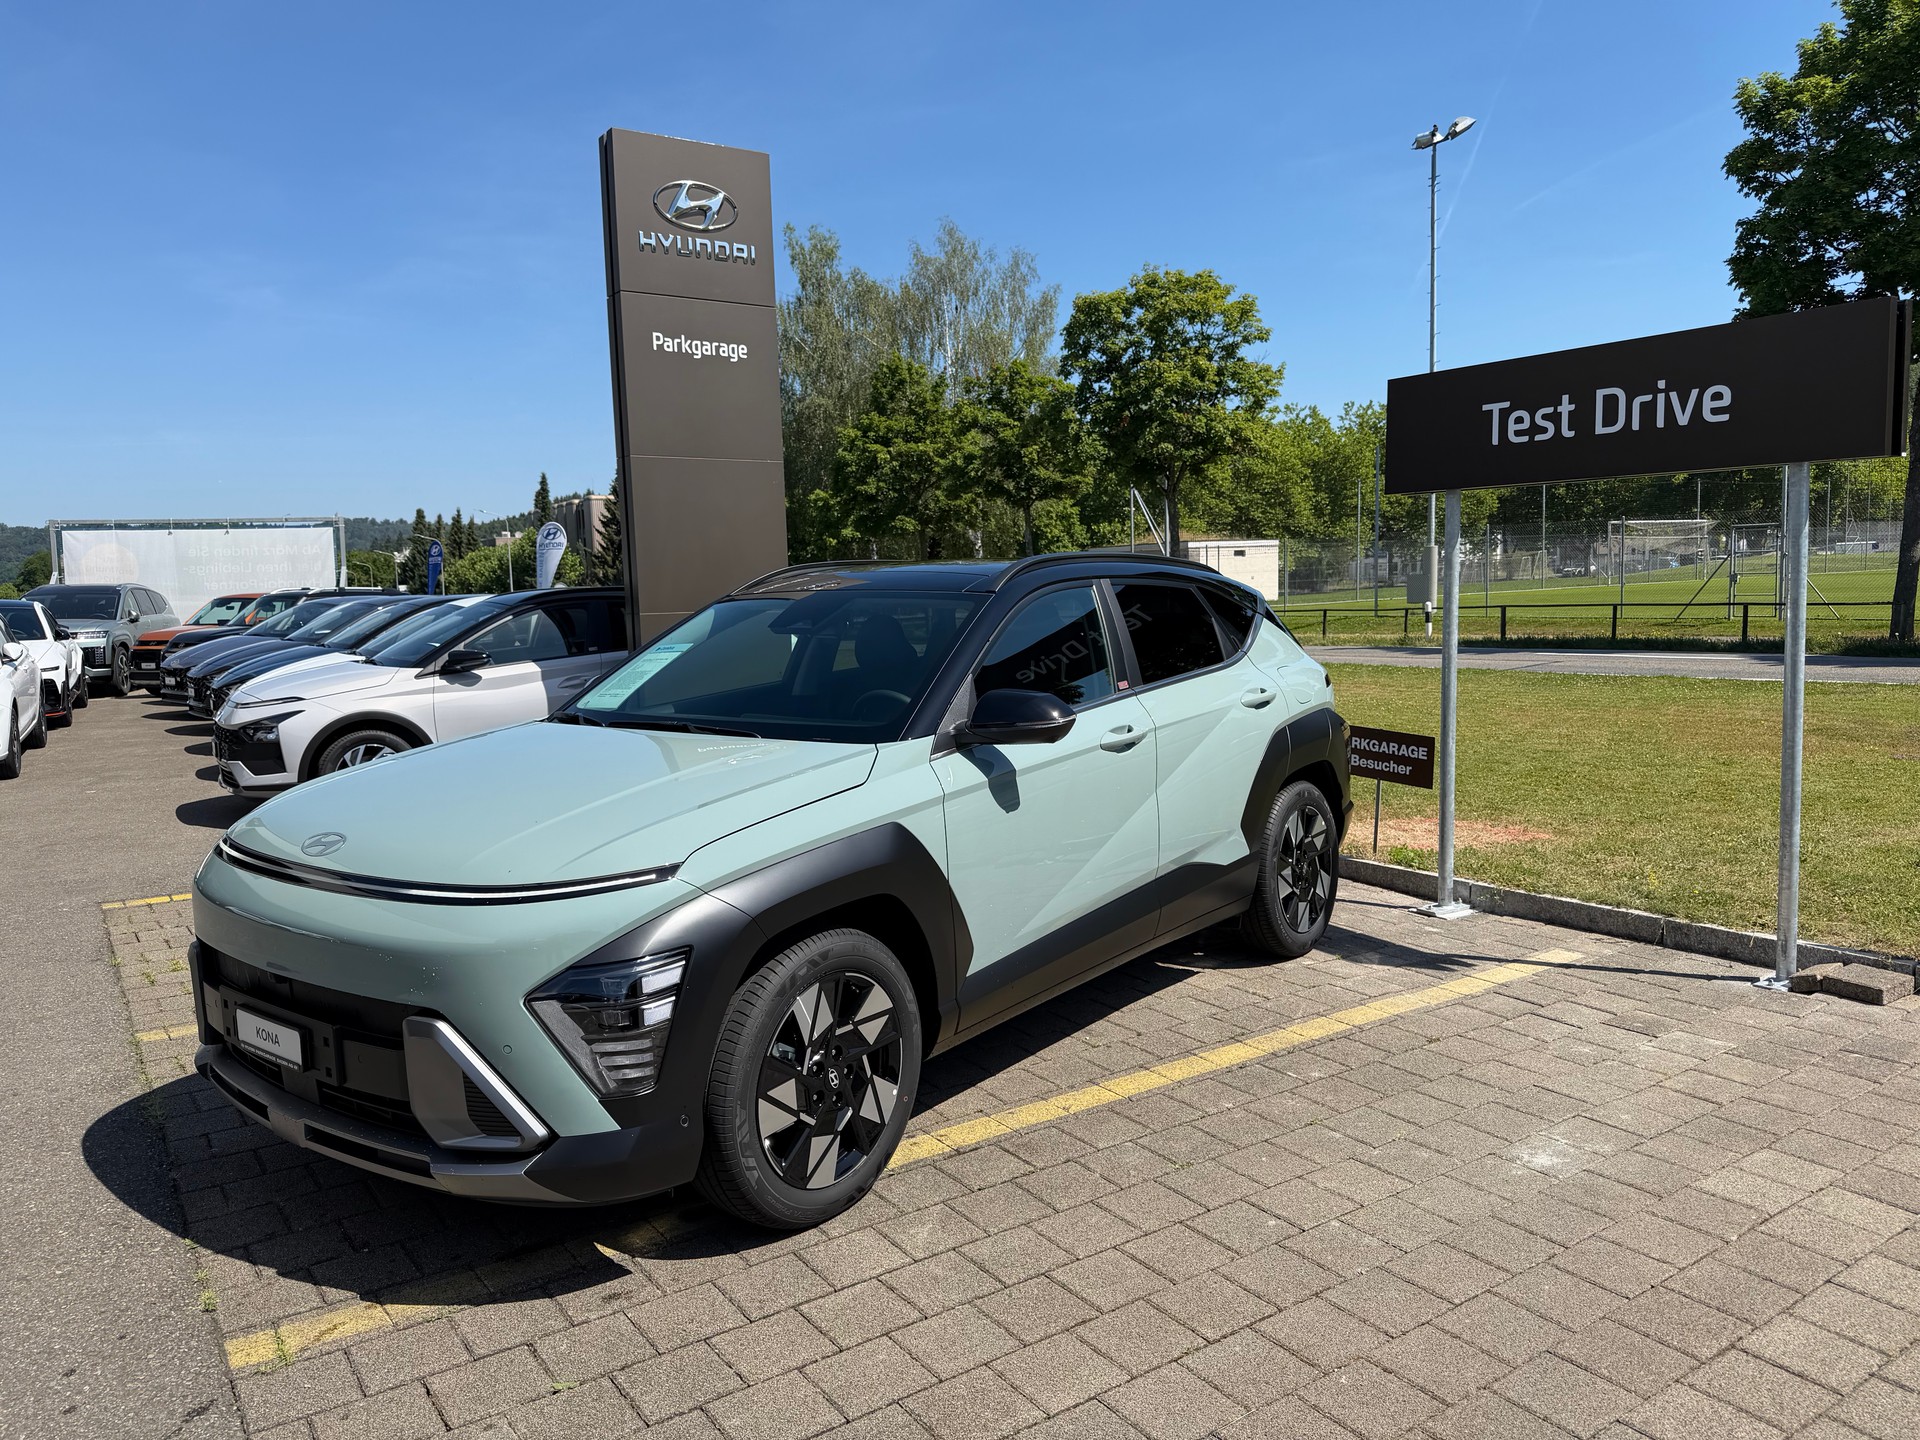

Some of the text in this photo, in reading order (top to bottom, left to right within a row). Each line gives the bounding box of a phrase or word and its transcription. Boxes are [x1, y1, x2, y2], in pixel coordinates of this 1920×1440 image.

[638, 229, 756, 265] HYUNDAI
[652, 331, 748, 362] Parkgarage
[1481, 379, 1732, 446] Test Drive
[1351, 736, 1428, 760] RKGARAGE
[1350, 753, 1413, 775] Besucher
[255, 1025, 281, 1048] KONA
